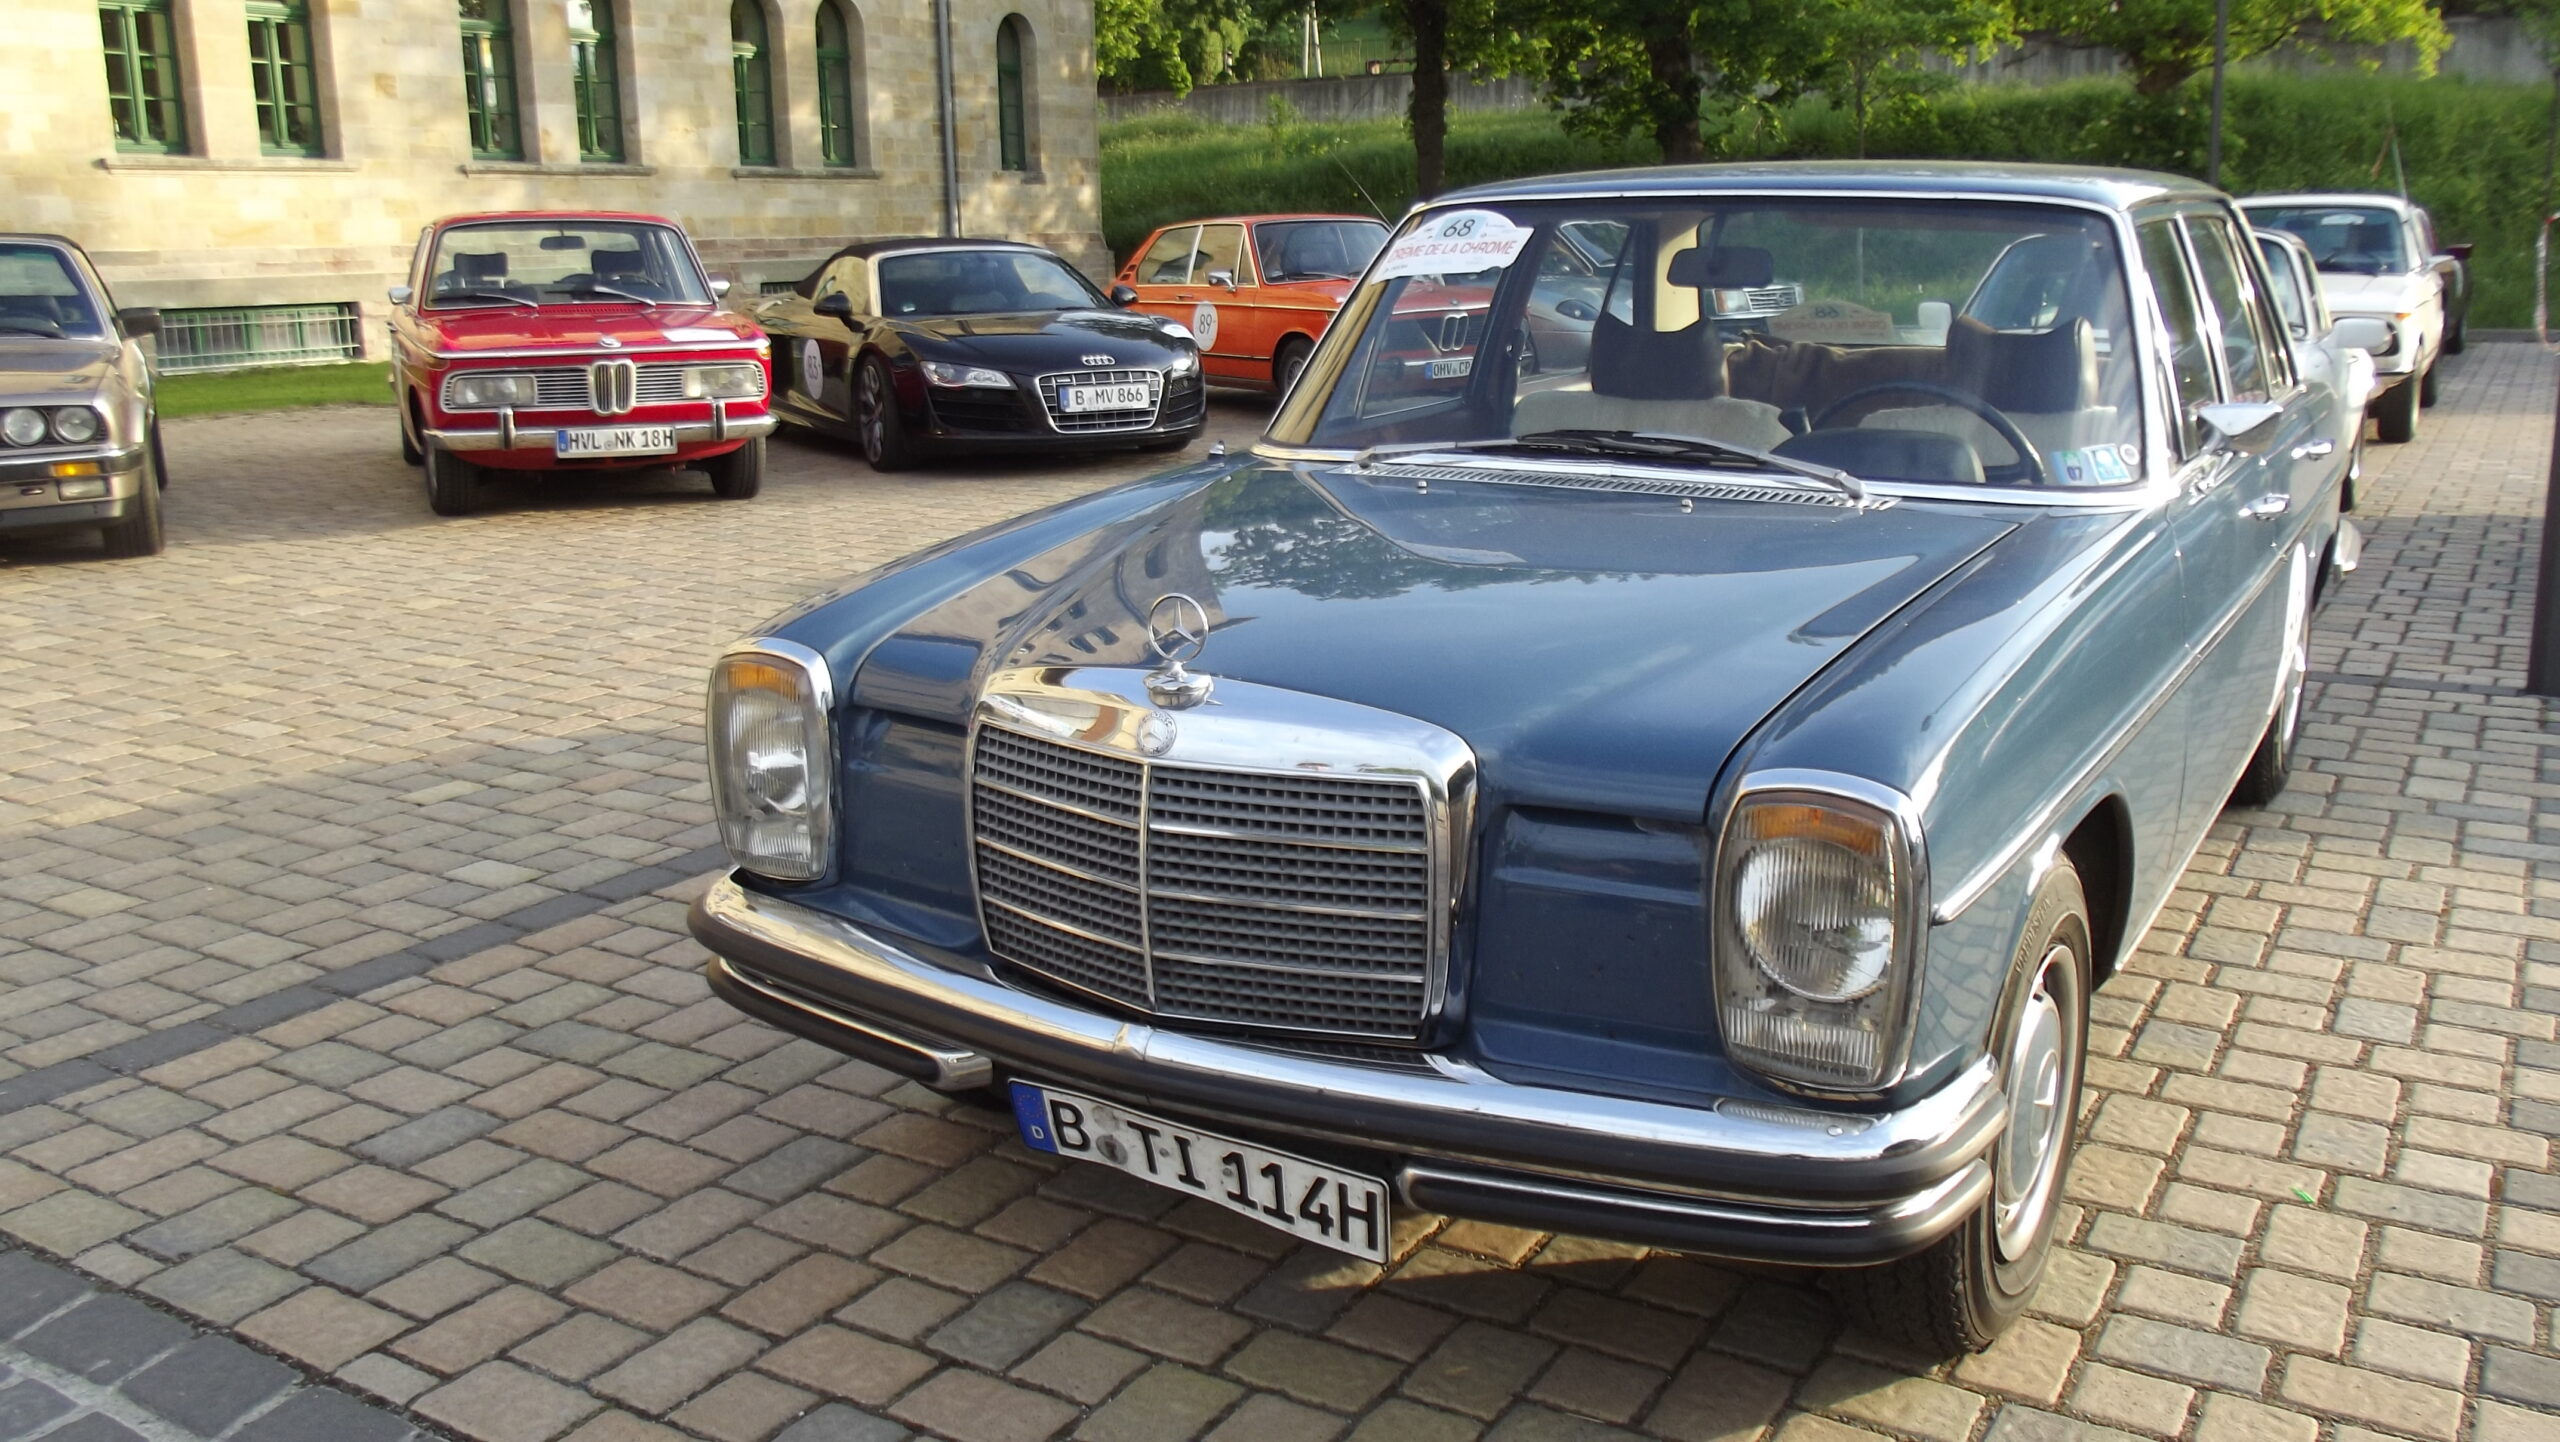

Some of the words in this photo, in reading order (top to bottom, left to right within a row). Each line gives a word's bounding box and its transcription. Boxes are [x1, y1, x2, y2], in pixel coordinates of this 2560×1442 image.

[1443, 218, 1476, 238] 68
[1424, 243, 1444, 256] DE
[1441, 242, 1458, 255] LA
[1460, 239, 1518, 255] CHROME
[1199, 313, 1213, 335] 89
[807, 354, 819, 381] 83
[1433, 362, 1453, 377] OHV
[1075, 389, 1085, 405] B
[1095, 388, 1114, 404] MV
[1117, 387, 1143, 403] 866
[569, 432, 602, 450] HVL
[614, 431, 636, 448] NK
[641, 429, 674, 447] 18H
[1049, 1099, 1091, 1151] B
[1126, 1119, 1206, 1191] TI
[1222, 1150, 1380, 1252] 114H
